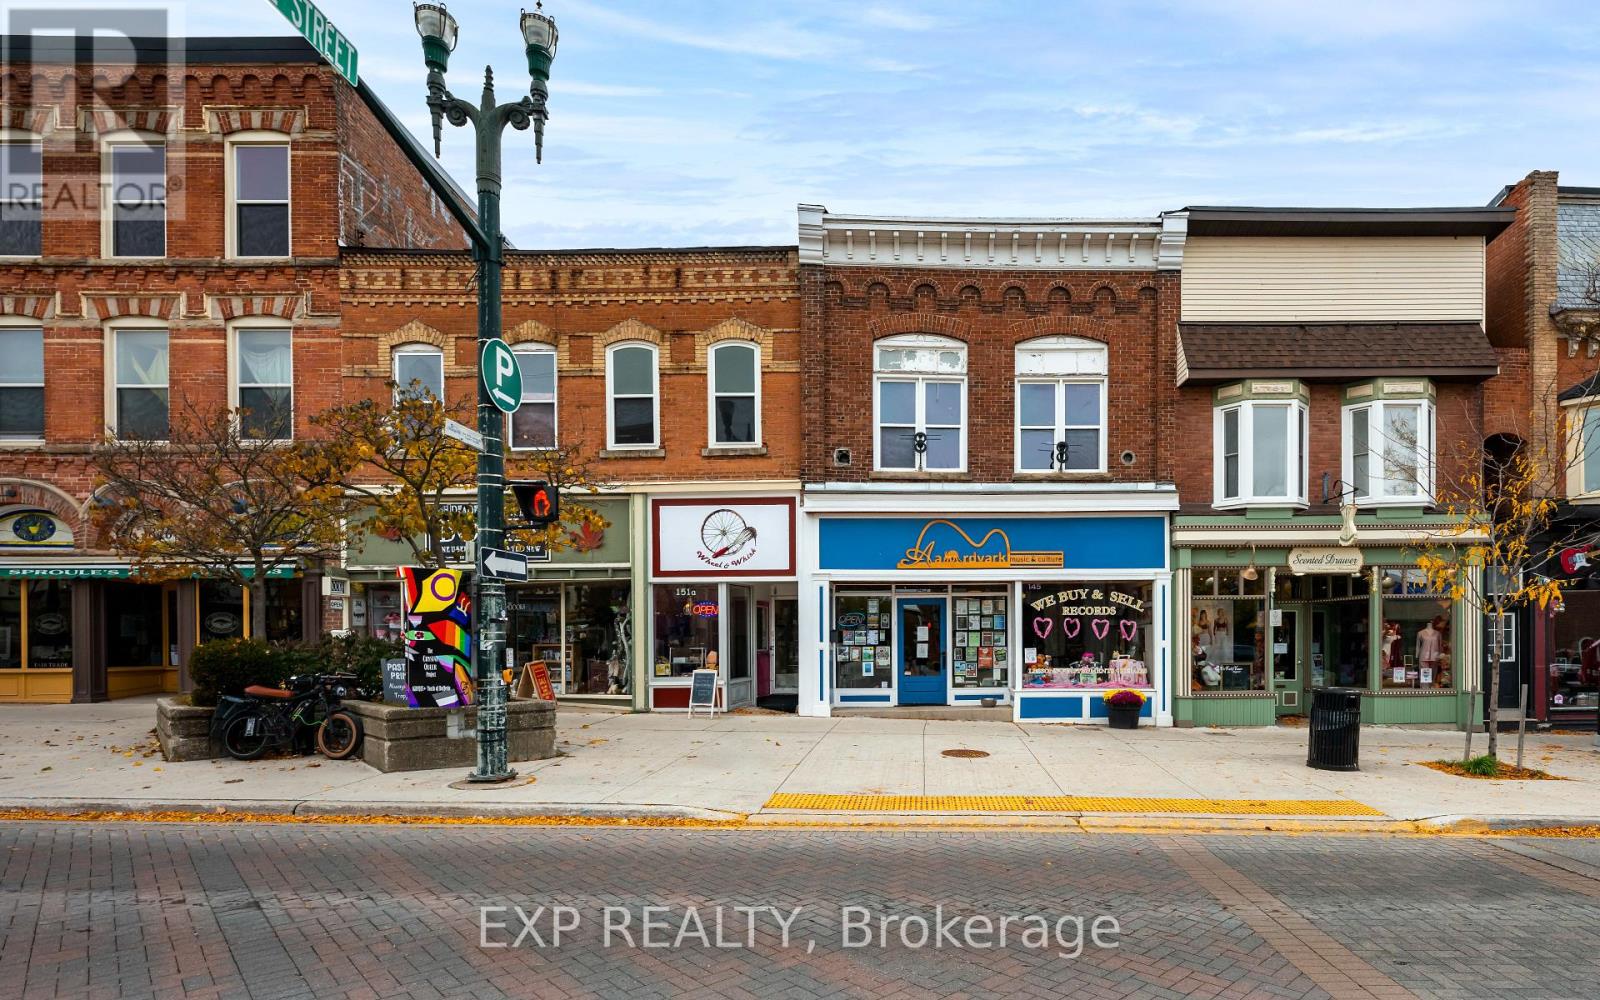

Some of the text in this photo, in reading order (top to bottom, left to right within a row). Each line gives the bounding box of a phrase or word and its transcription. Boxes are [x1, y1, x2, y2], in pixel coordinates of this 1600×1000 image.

[291, 0, 355, 80] STREET
[496, 346, 514, 387] P
[696, 550, 722, 568] Wheel
[731, 548, 756, 566] Whisk
[900, 541, 1006, 567] Aardvark
[1293, 553, 1358, 565] Scented Drawer
[675, 588, 696, 596] 151a
[1030, 588, 1145, 613] WE BUY & SELL
[693, 604, 719, 615] OPEN
[1062, 606, 1116, 616] RECORDS
